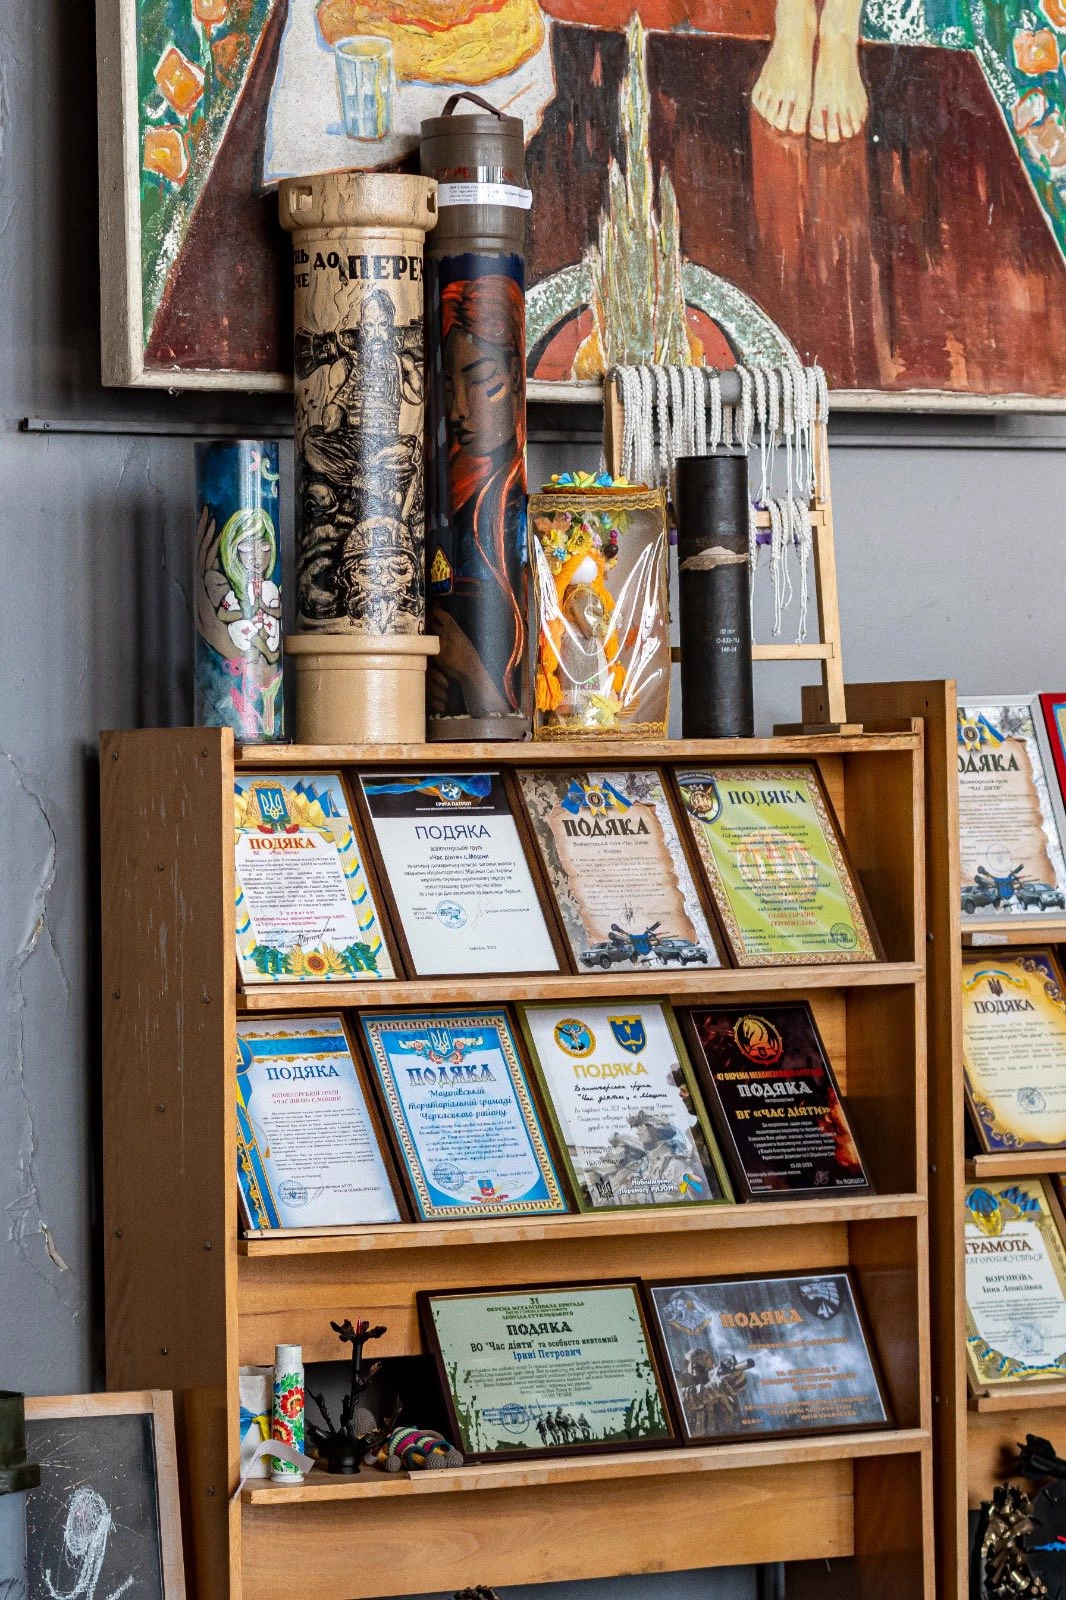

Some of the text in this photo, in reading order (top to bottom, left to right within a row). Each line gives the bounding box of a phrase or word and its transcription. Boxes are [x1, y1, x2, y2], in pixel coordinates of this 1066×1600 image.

[313, 252, 340, 270] ДО
[727, 790, 807, 807] ПОДЯКА
[415, 825, 491, 841] ПОДЯКА
[561, 817, 651, 838] ПОДЯКА
[248, 838, 317, 850] ПОДЯКА
[973, 999, 1036, 1016] ПОДЯКА
[266, 1064, 340, 1082] ПОДЯКА
[405, 1063, 497, 1088] ПОДЯКА
[573, 1061, 648, 1080] ПОДЯКА
[736, 1081, 813, 1098] ПОДЯКА
[735, 1105, 831, 1120] ВГ «ЧАС ДІЯТИ»
[719, 1307, 804, 1329] ПОДЯКА
[506, 1321, 573, 1336] ПОДЯКА
[470, 1342, 483, 1352] ВО
[548, 1338, 580, 1348] особисто
[513, 1347, 582, 1362] Ірині Петрович
